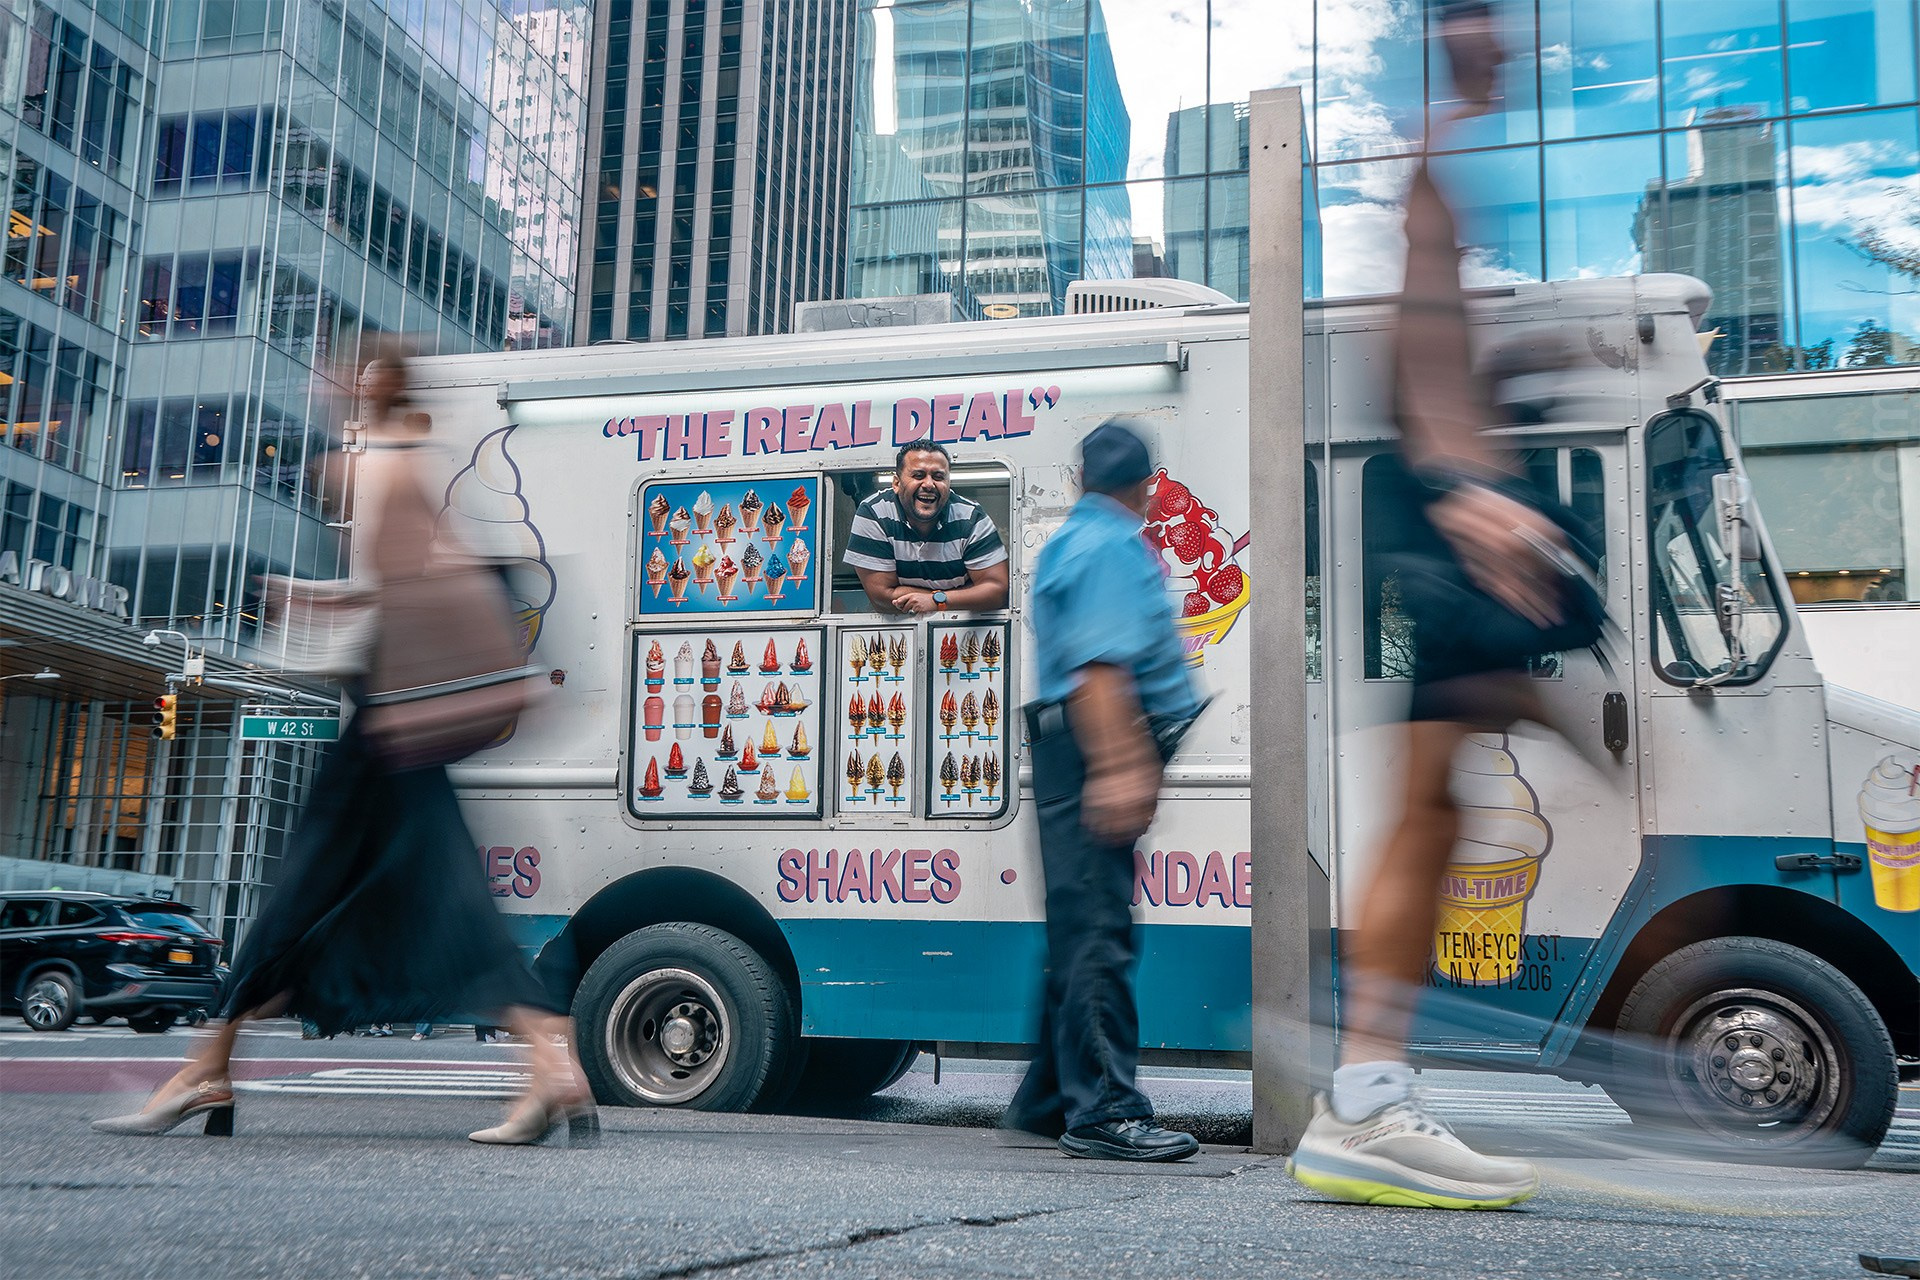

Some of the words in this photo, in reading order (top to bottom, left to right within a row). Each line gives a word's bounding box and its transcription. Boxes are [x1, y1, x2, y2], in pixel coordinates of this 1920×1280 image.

[743, 400, 882, 456] REAL
[267, 721, 277, 735] W
[280, 721, 297, 736] 42
[301, 722, 314, 736] St
[776, 848, 962, 905] SHAKES
[1131, 850, 1251, 908] NDAE
[1439, 871, 1528, 900] UN-TIME
[1439, 932, 1530, 961] TEN-EYCK
[1537, 934, 1565, 962] ST.
[1450, 961, 1486, 989] N.Y.
[1493, 963, 1552, 992] 11206
